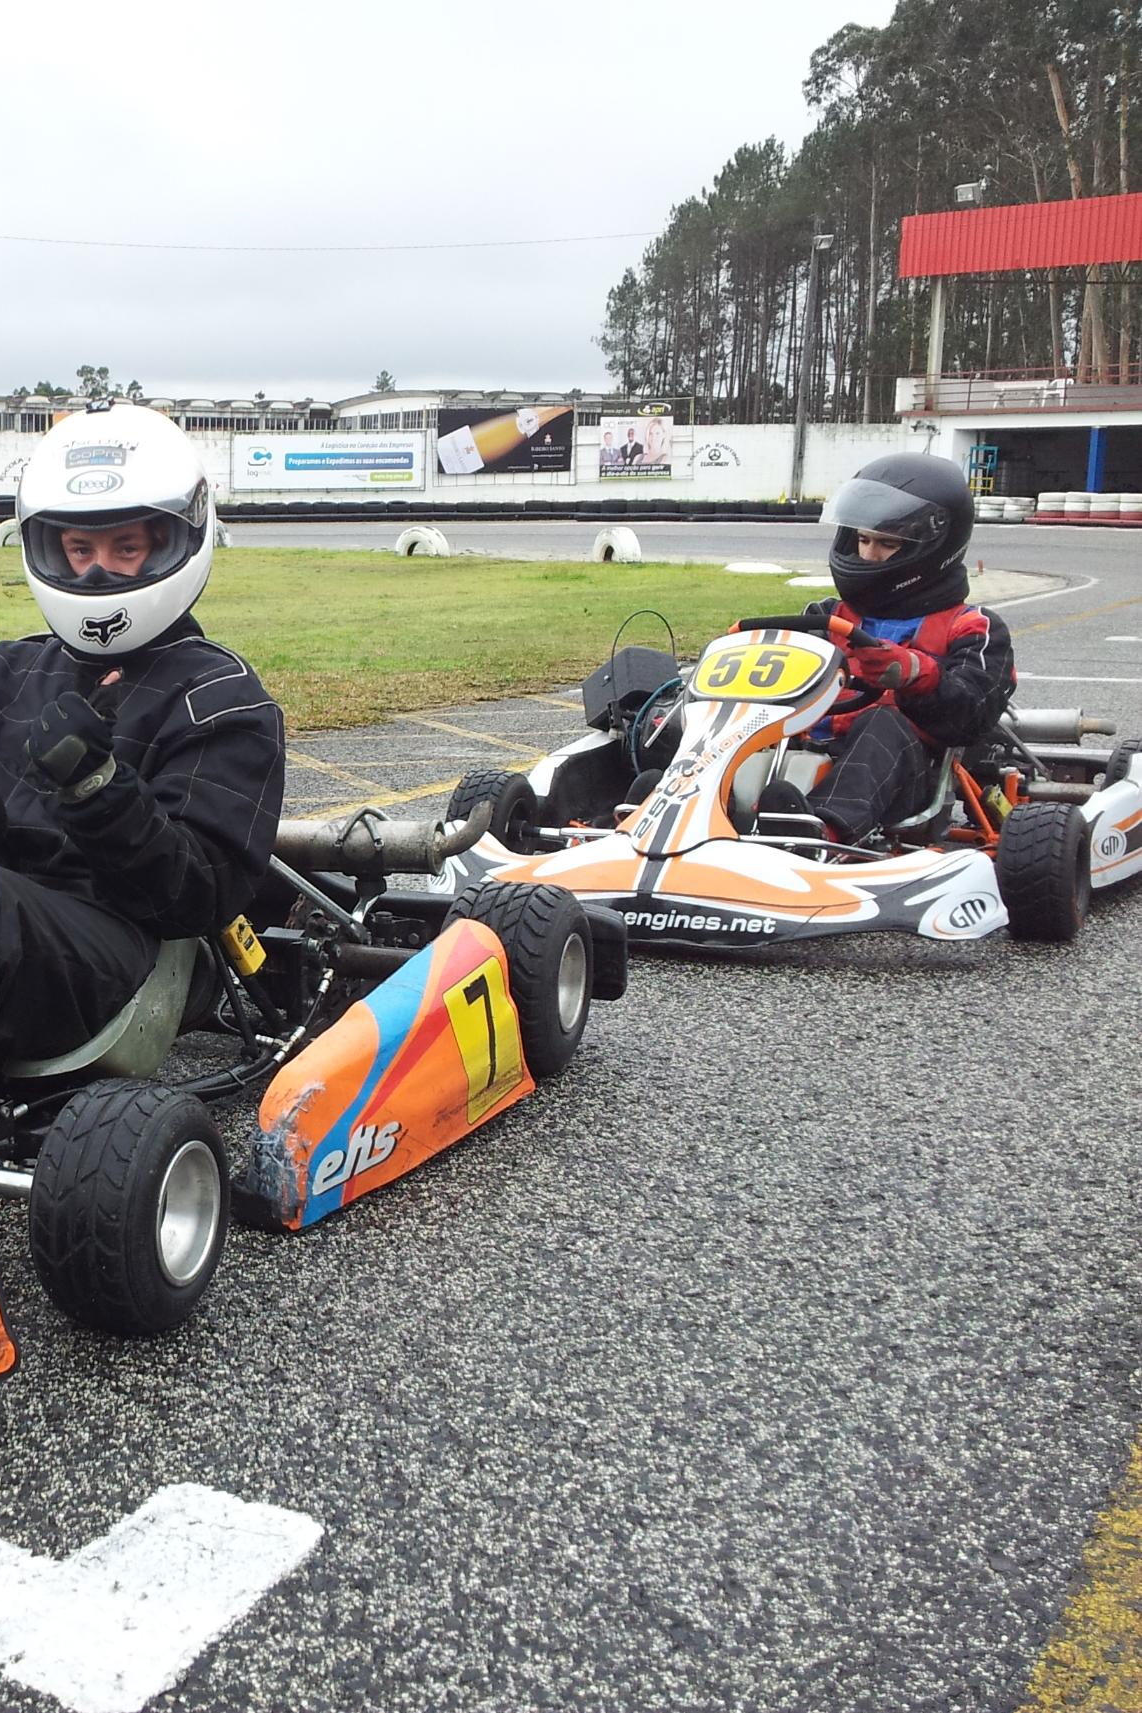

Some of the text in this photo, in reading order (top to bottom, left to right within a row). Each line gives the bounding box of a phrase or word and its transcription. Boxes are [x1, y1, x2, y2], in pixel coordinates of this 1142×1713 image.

[707, 649, 791, 688] 55
[618, 909, 776, 934] engines.net
[462, 974, 497, 1089] 7
